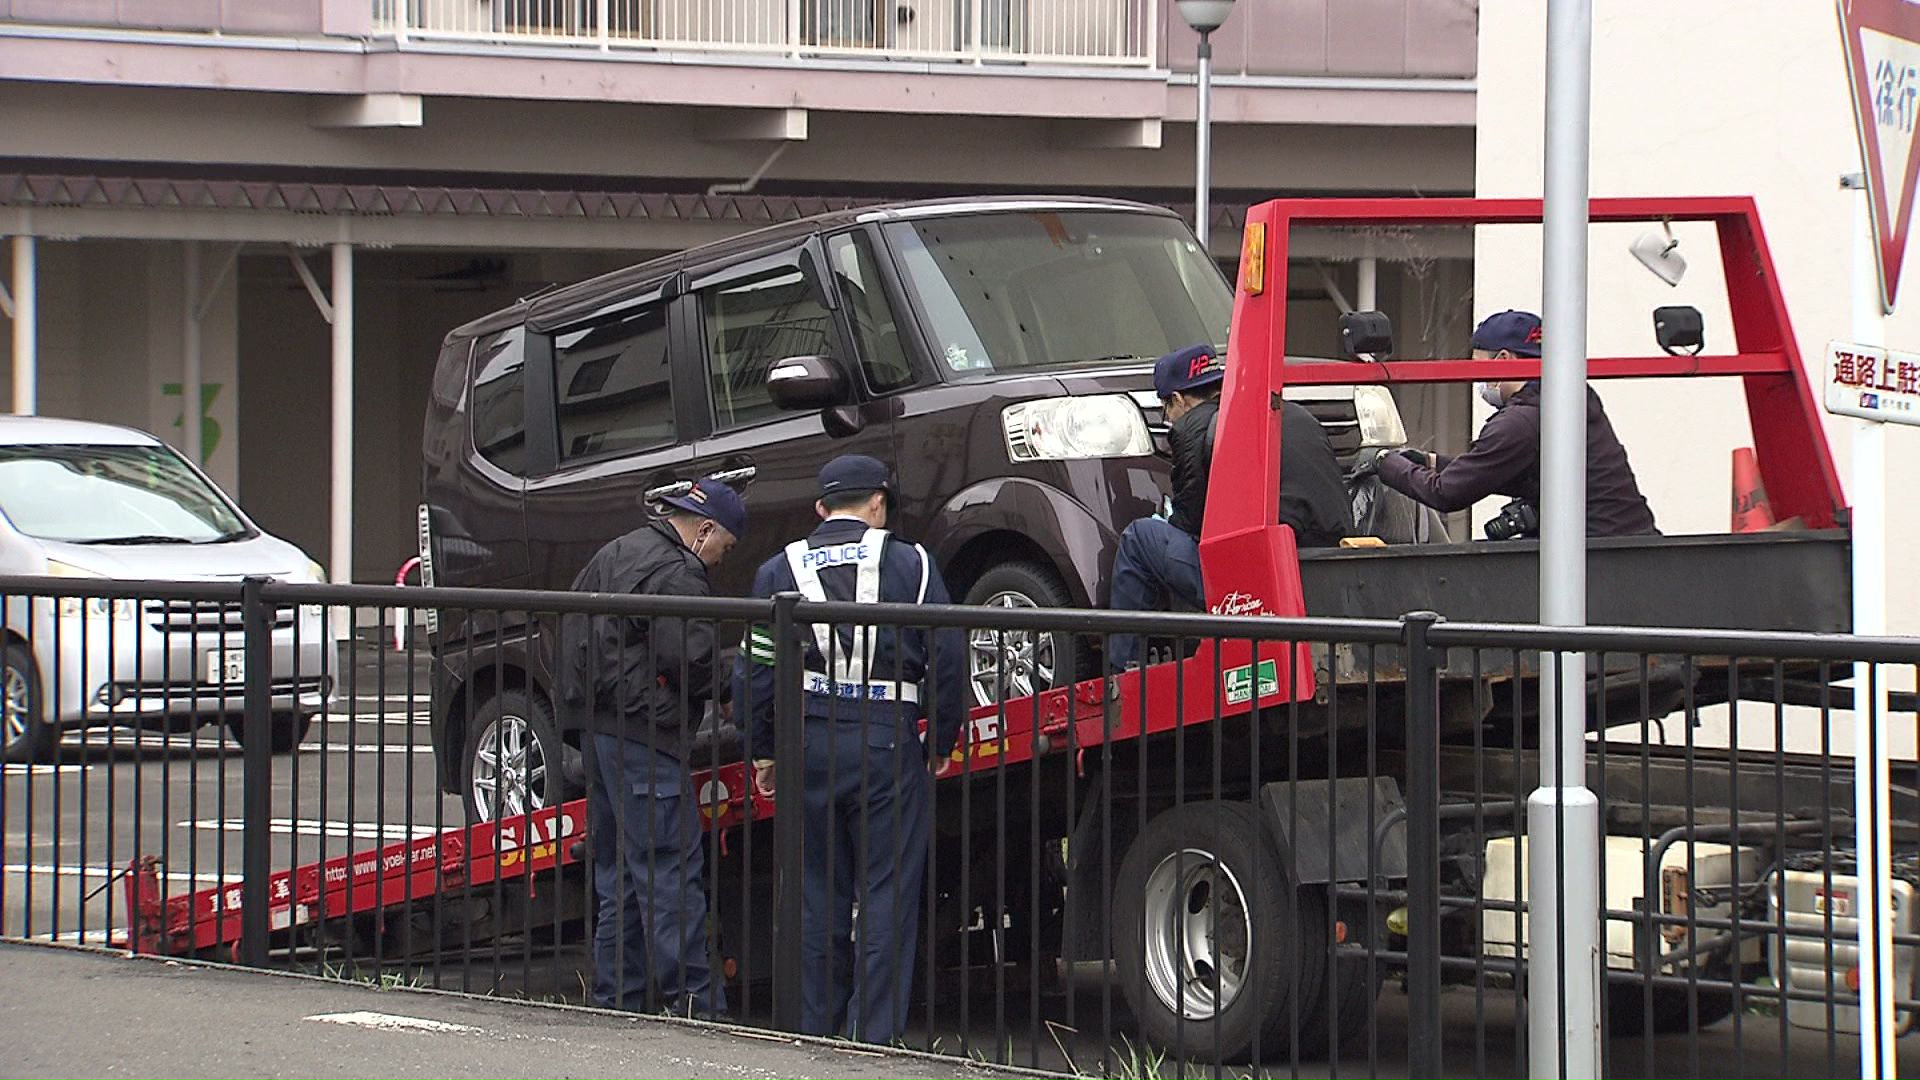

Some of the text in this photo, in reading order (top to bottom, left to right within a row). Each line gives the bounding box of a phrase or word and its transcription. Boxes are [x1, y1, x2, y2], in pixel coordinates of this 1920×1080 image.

[1875, 60, 1917, 133] 徐行
[1833, 351, 1920, 396] 通路上駐
[802, 544, 869, 568] POLICE
